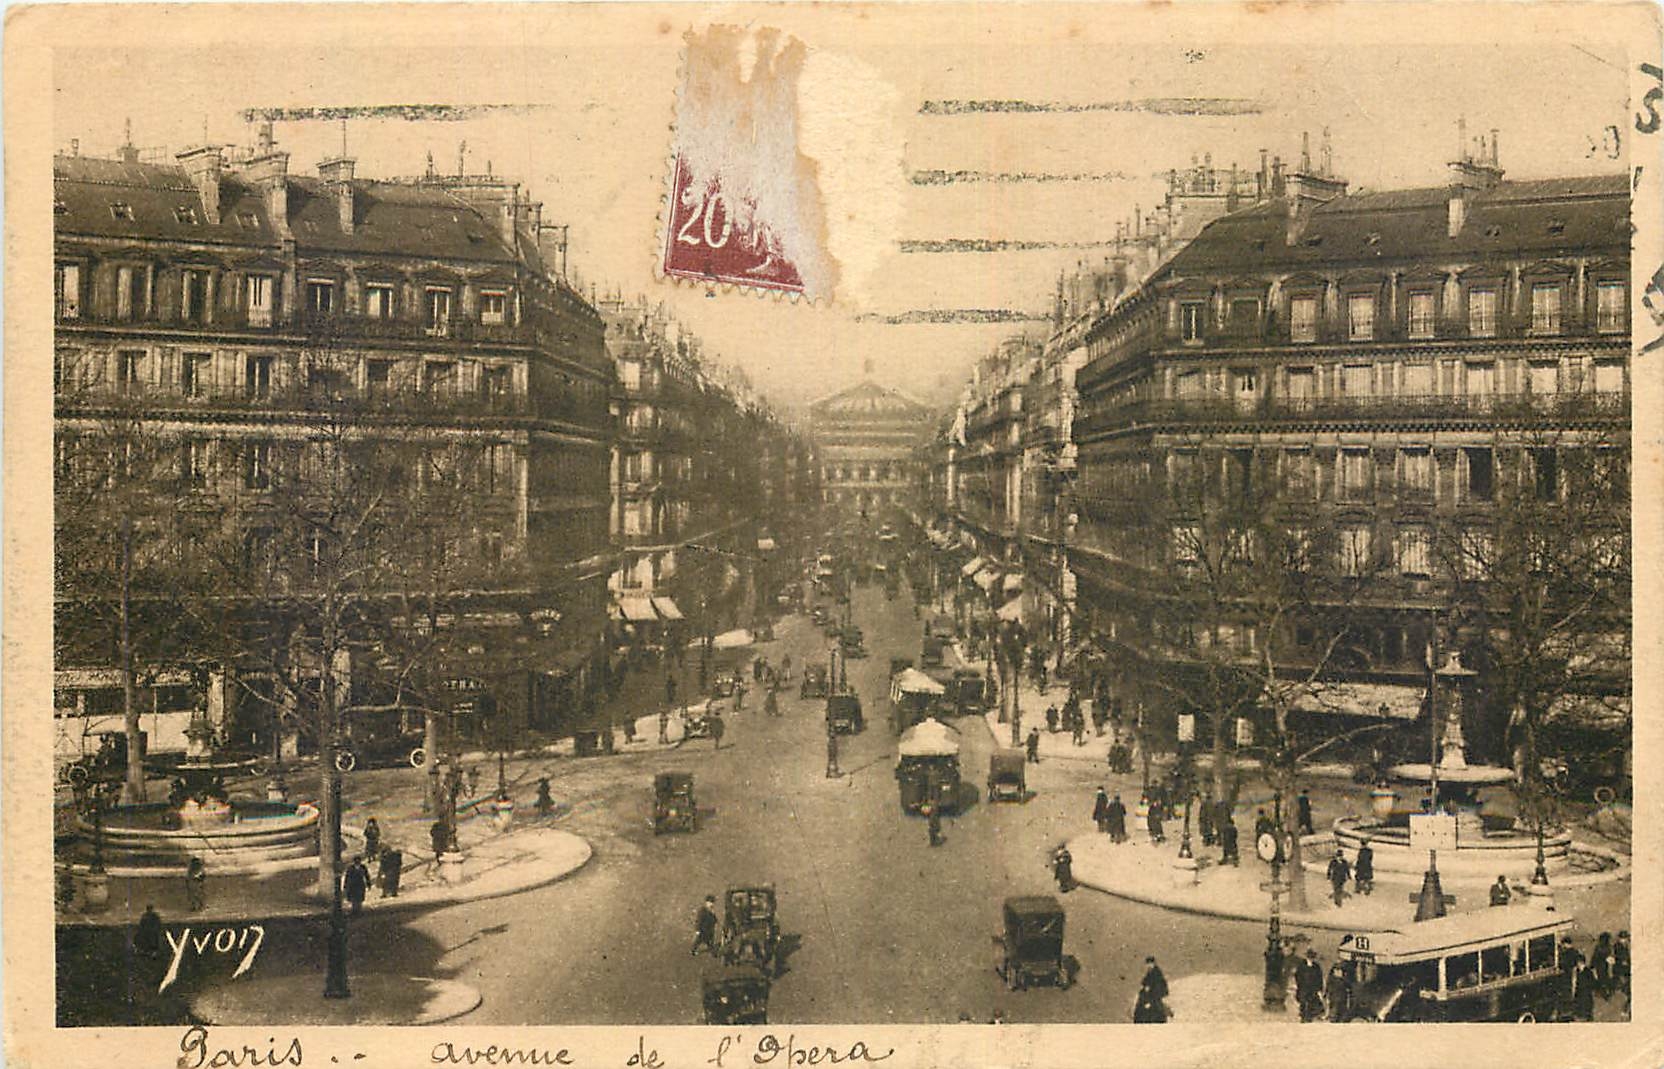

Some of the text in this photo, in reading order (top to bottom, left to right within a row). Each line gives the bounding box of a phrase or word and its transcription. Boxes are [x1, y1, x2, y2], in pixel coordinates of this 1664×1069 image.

[676, 187, 733, 248] 20
[177, 1024, 303, 1069] Paris
[431, 1042, 575, 1065] avenue
[627, 1035, 665, 1069] de
